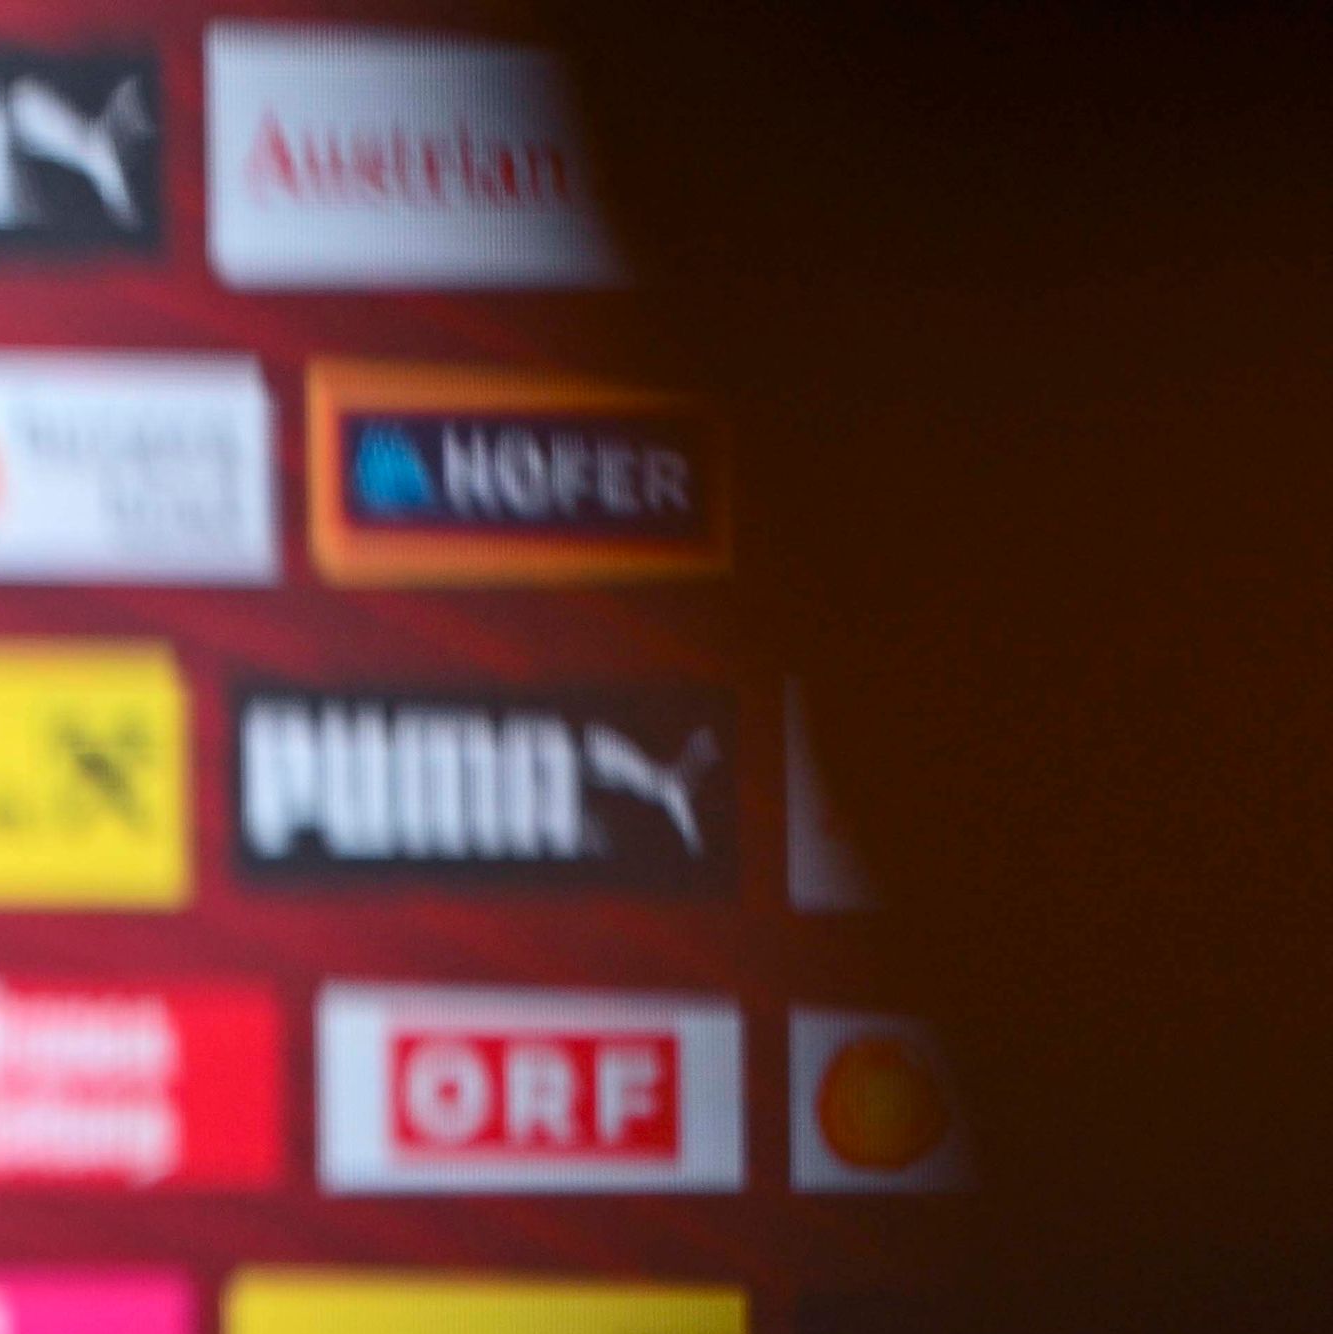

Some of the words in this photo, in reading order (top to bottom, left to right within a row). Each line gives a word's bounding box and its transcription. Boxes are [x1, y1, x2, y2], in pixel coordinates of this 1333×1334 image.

[439, 420, 693, 516] HOFER
[241, 694, 583, 858] PUMA
[401, 1040, 665, 1146] ORF
